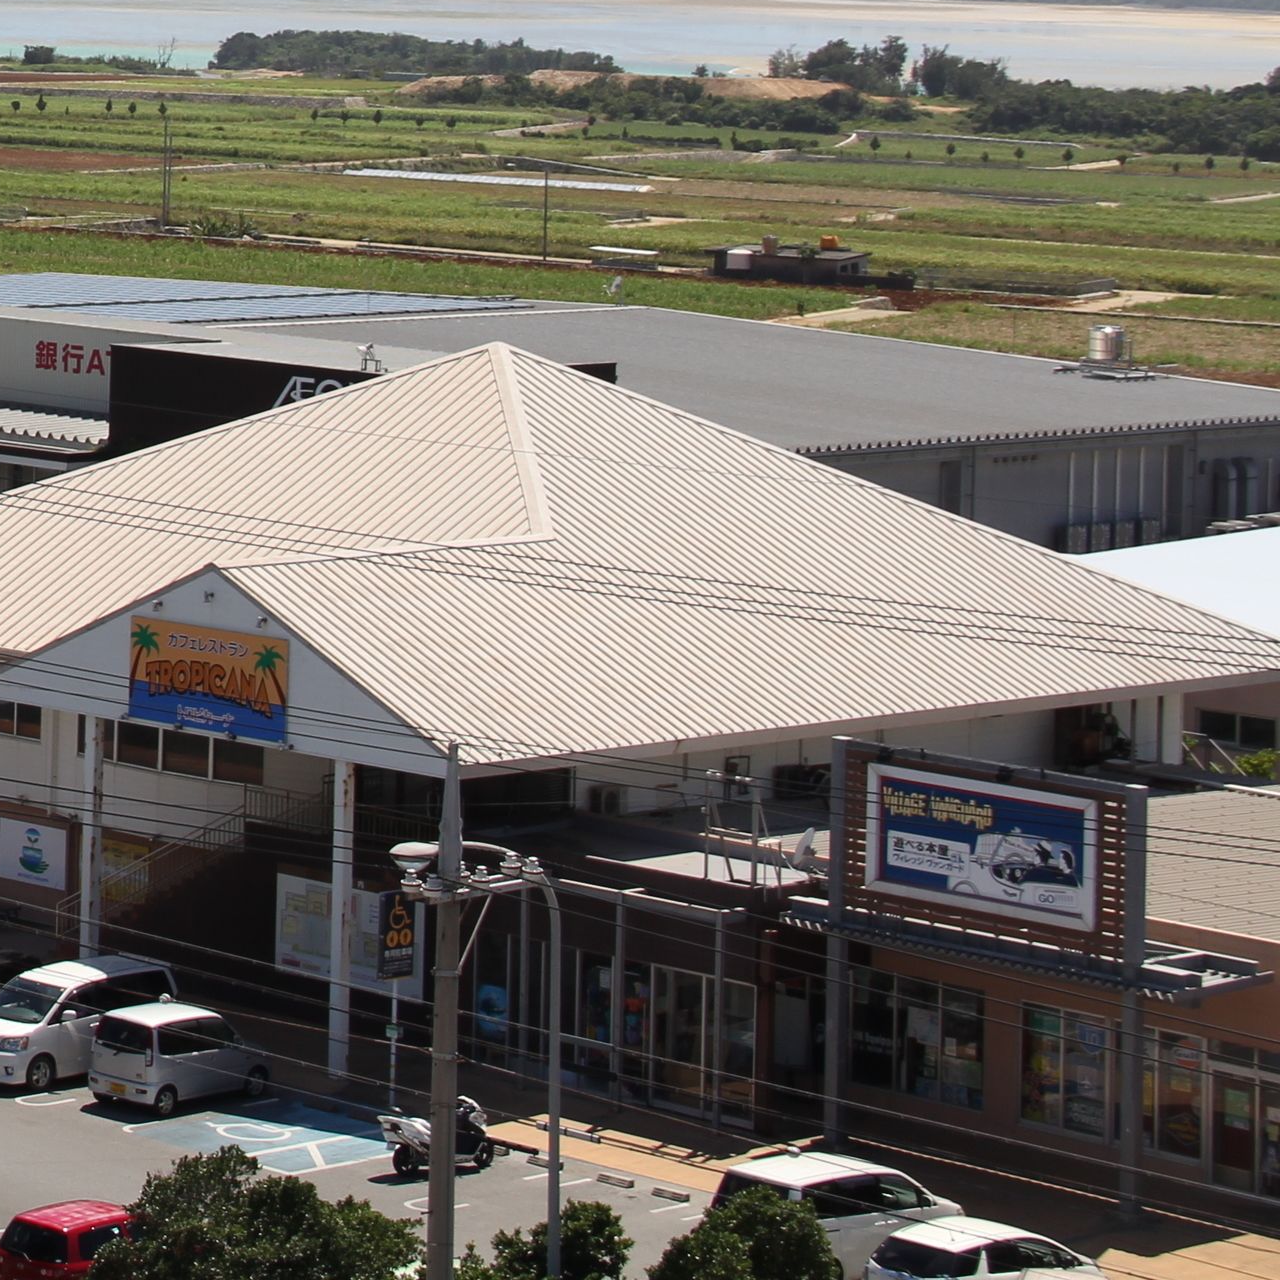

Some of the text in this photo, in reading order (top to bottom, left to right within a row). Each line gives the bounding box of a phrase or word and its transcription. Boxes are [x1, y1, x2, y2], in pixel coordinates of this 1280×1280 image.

[168, 632, 248, 658] カフェレストラン
[145, 659, 273, 719] TROPICANA
